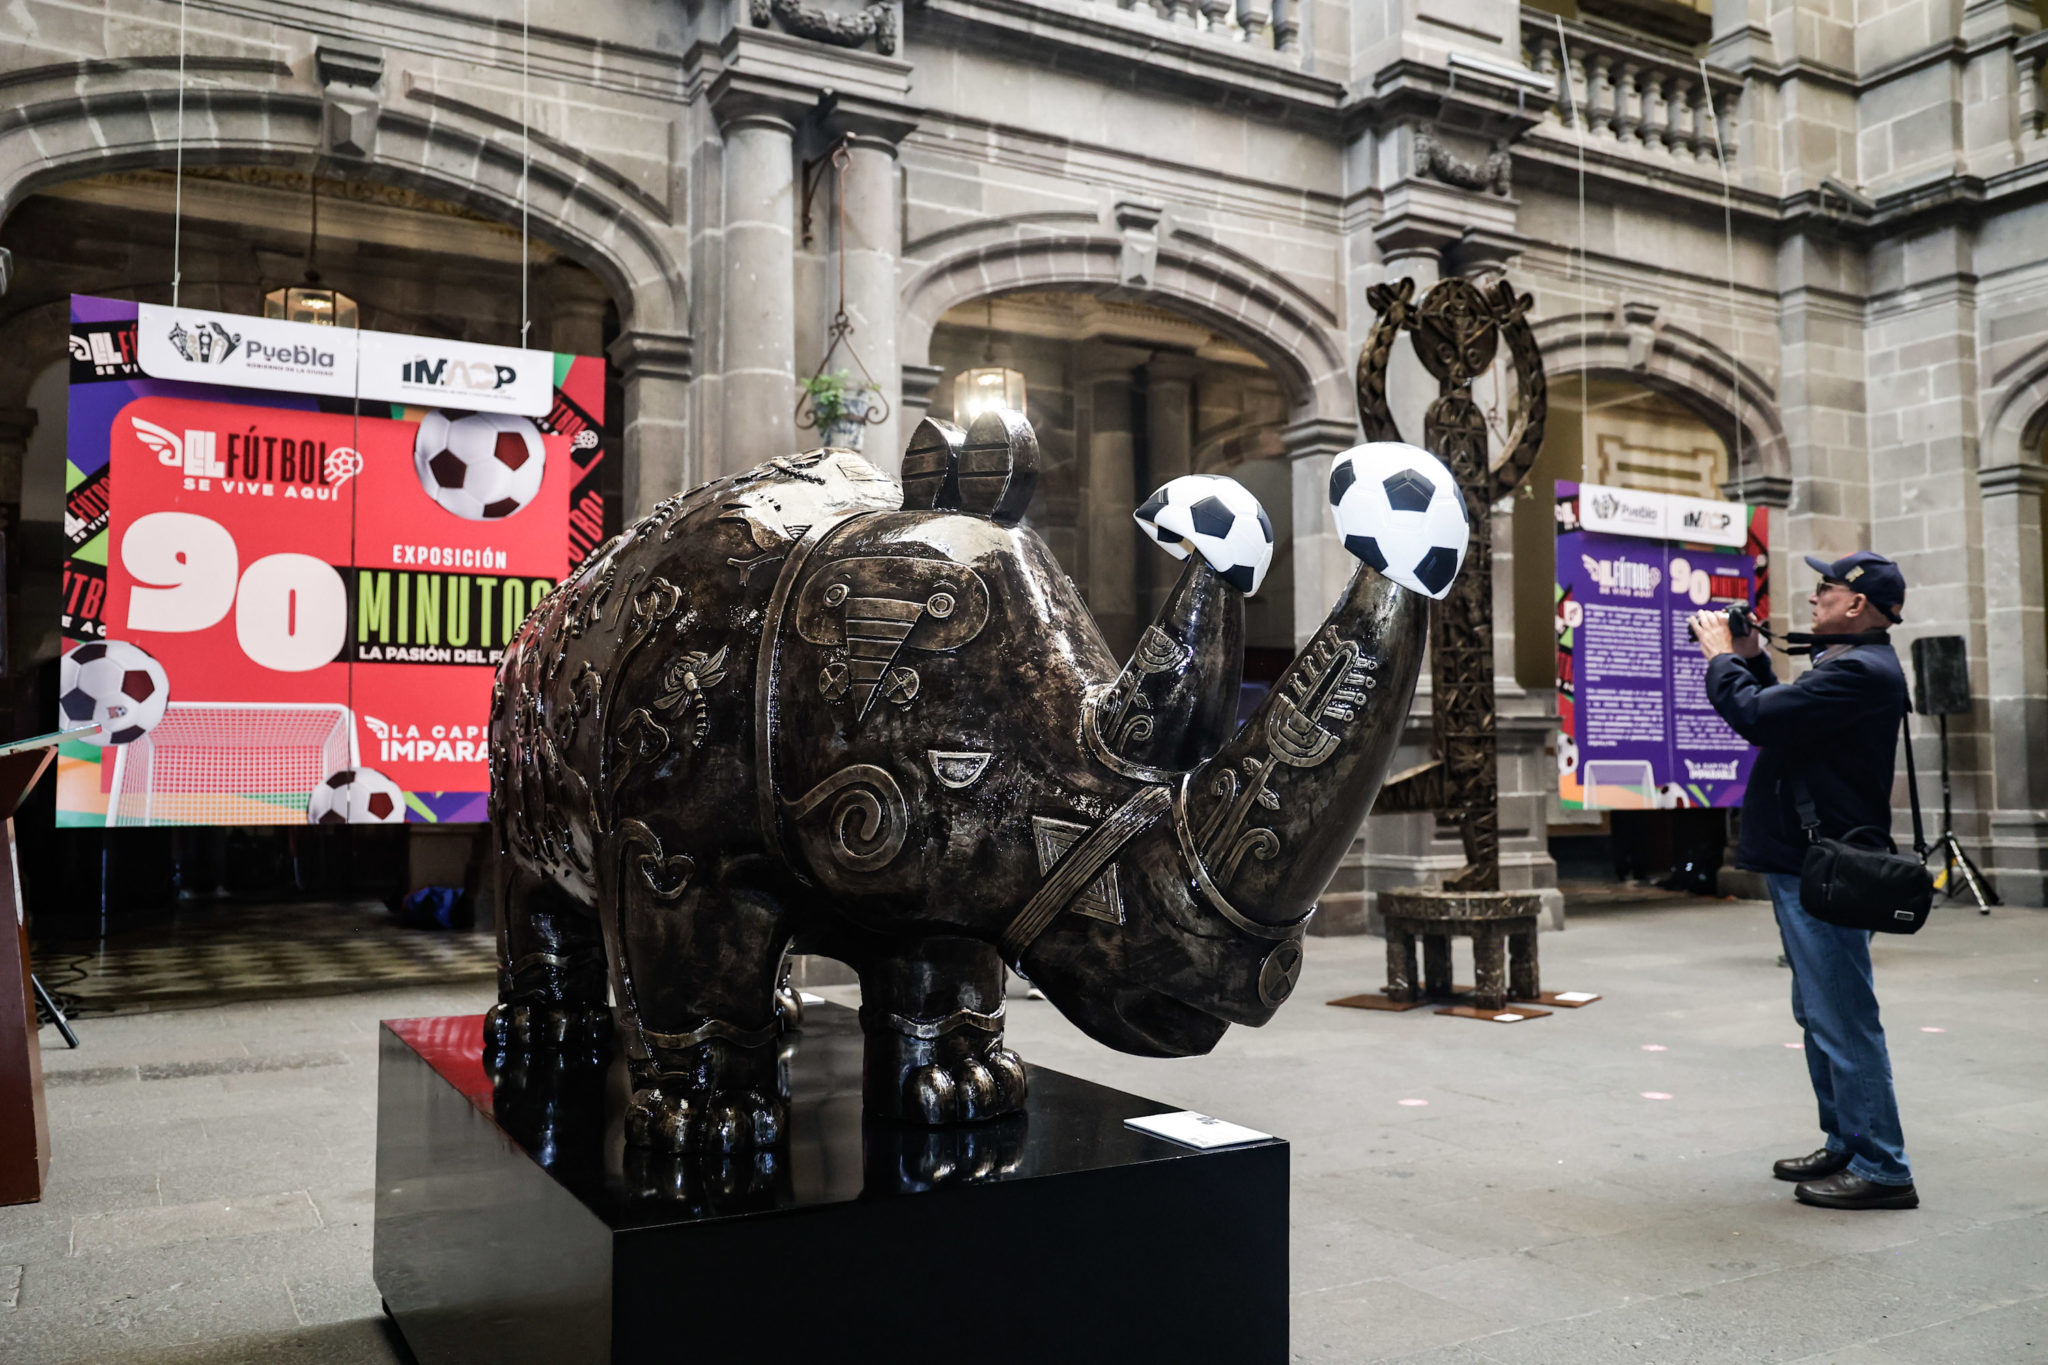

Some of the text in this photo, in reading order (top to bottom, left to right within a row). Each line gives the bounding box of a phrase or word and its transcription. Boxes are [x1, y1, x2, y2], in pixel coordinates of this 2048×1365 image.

[246, 340, 335, 368] Puebla
[95, 365, 115, 376] SE
[184, 425, 330, 485] EL FÚTBOL
[184, 478, 339, 501] SE VIVE AQUÍ
[393, 545, 507, 569] EXPOSICIÓN
[121, 512, 348, 671] 90
[359, 646, 382, 660] LA
[386, 646, 450, 662] PASIÓN
[454, 648, 487, 663] DEL
[392, 725, 488, 739] LA CAPI
[380, 740, 489, 762] IMPARA
